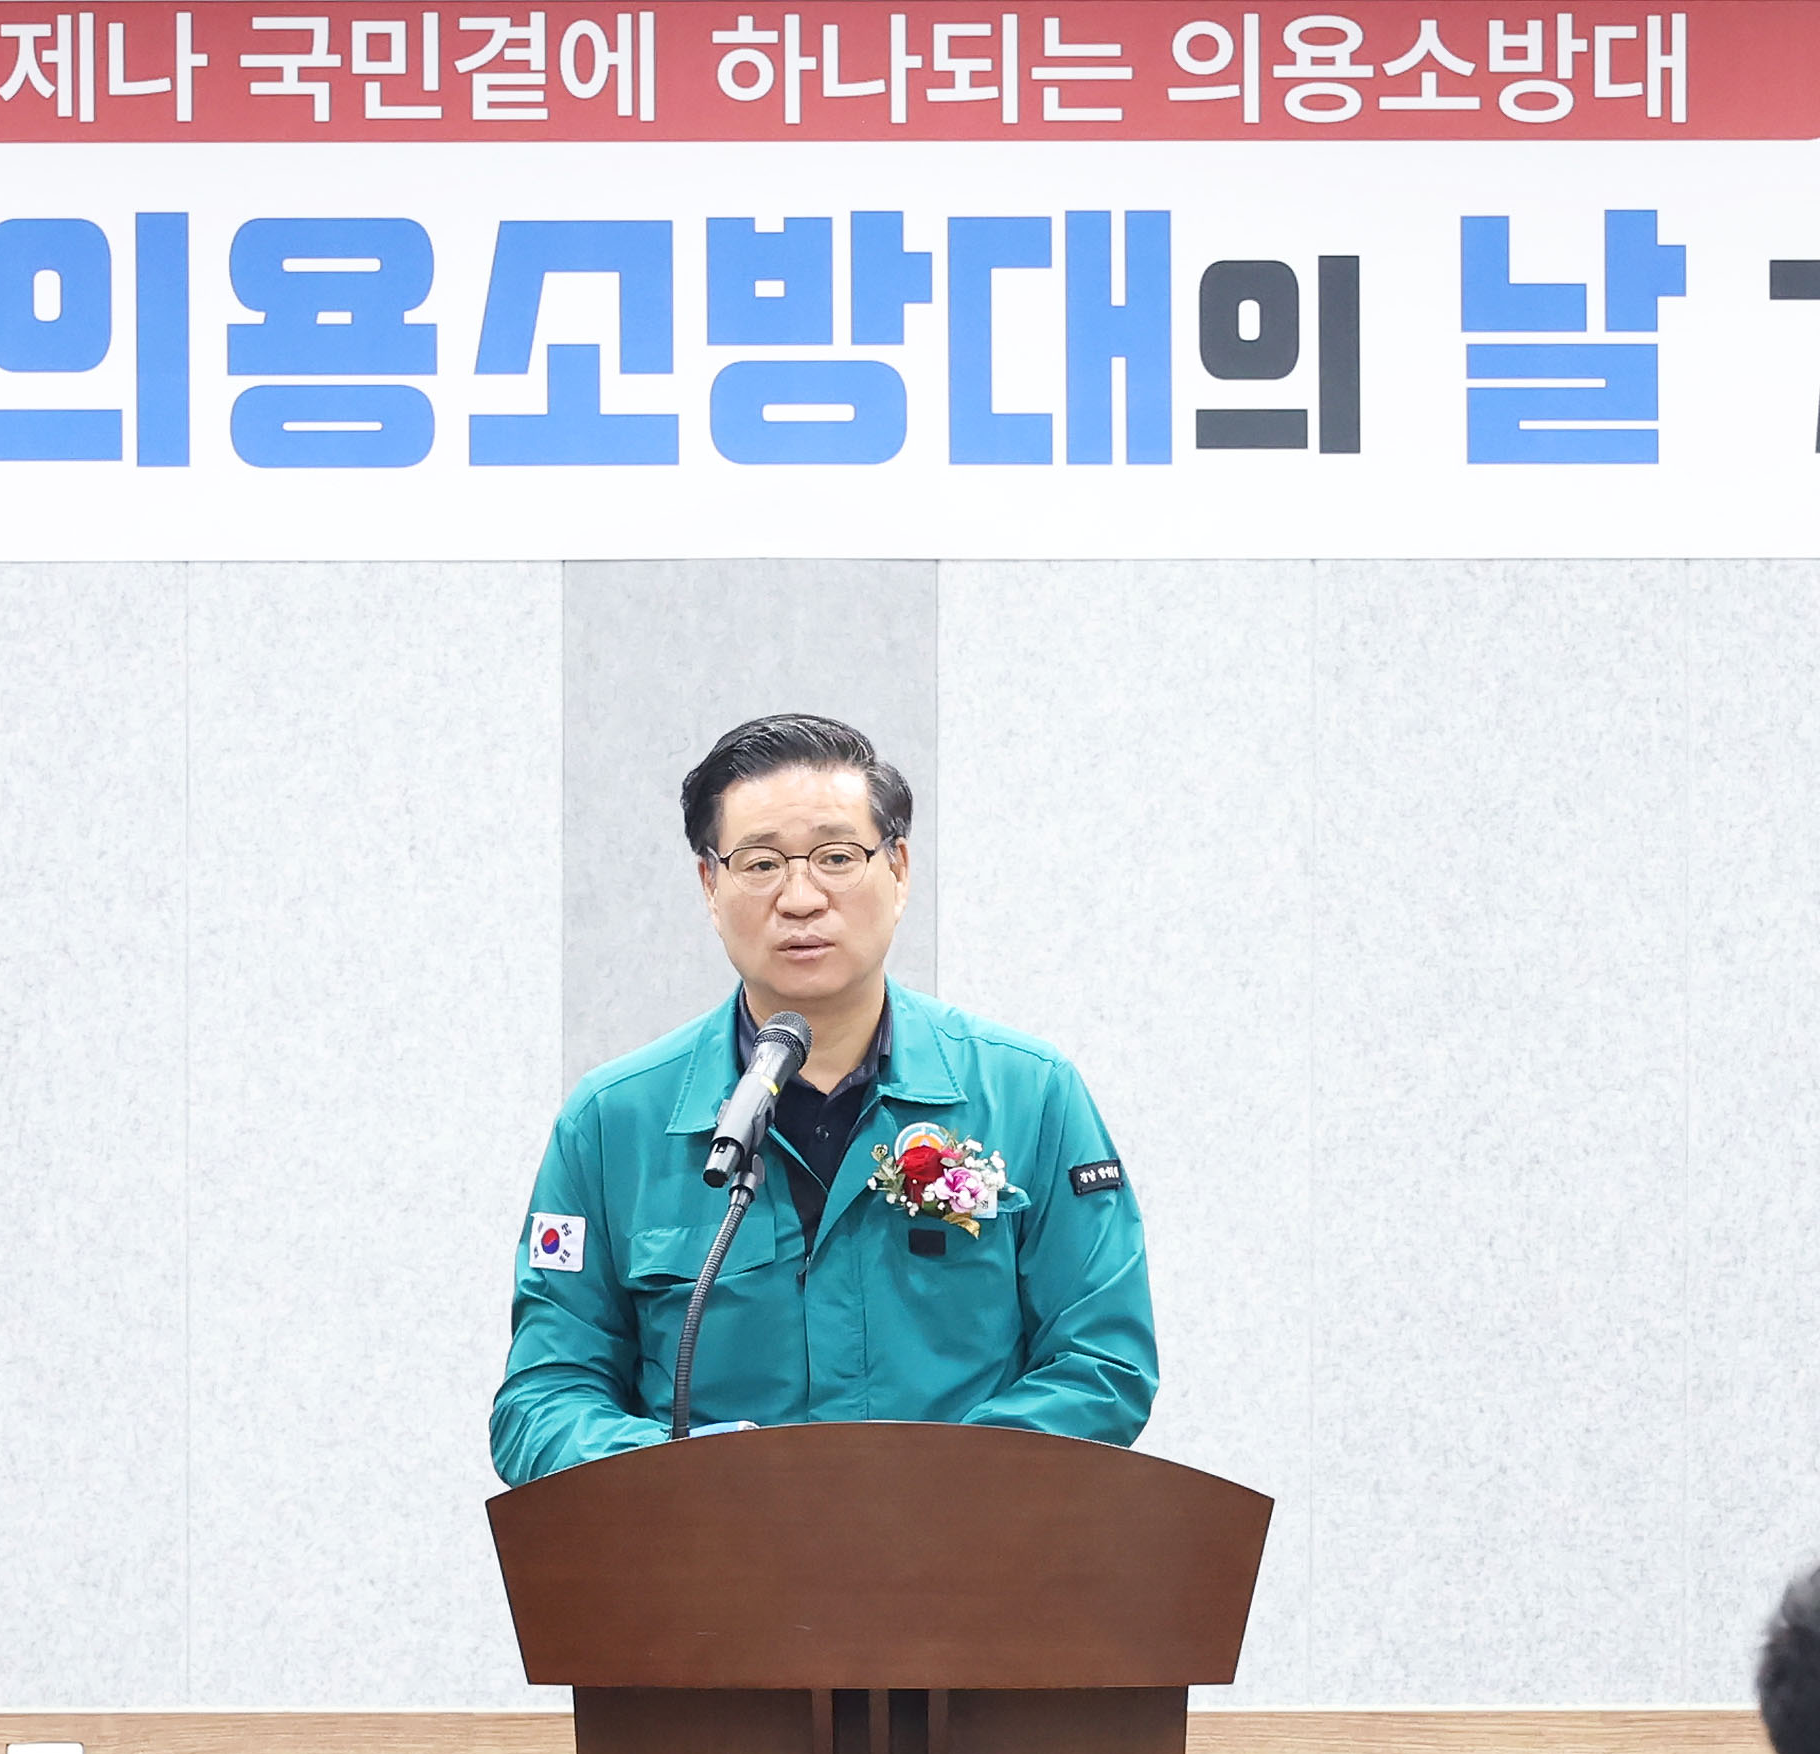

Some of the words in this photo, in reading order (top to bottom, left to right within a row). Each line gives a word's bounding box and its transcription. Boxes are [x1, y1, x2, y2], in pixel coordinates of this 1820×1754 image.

[241, 12, 654, 121] 국민곁에
[713, 14, 1132, 123] 하나되는
[1168, 14, 1686, 122] 의용소방대
[1462, 210, 1686, 464] 날
